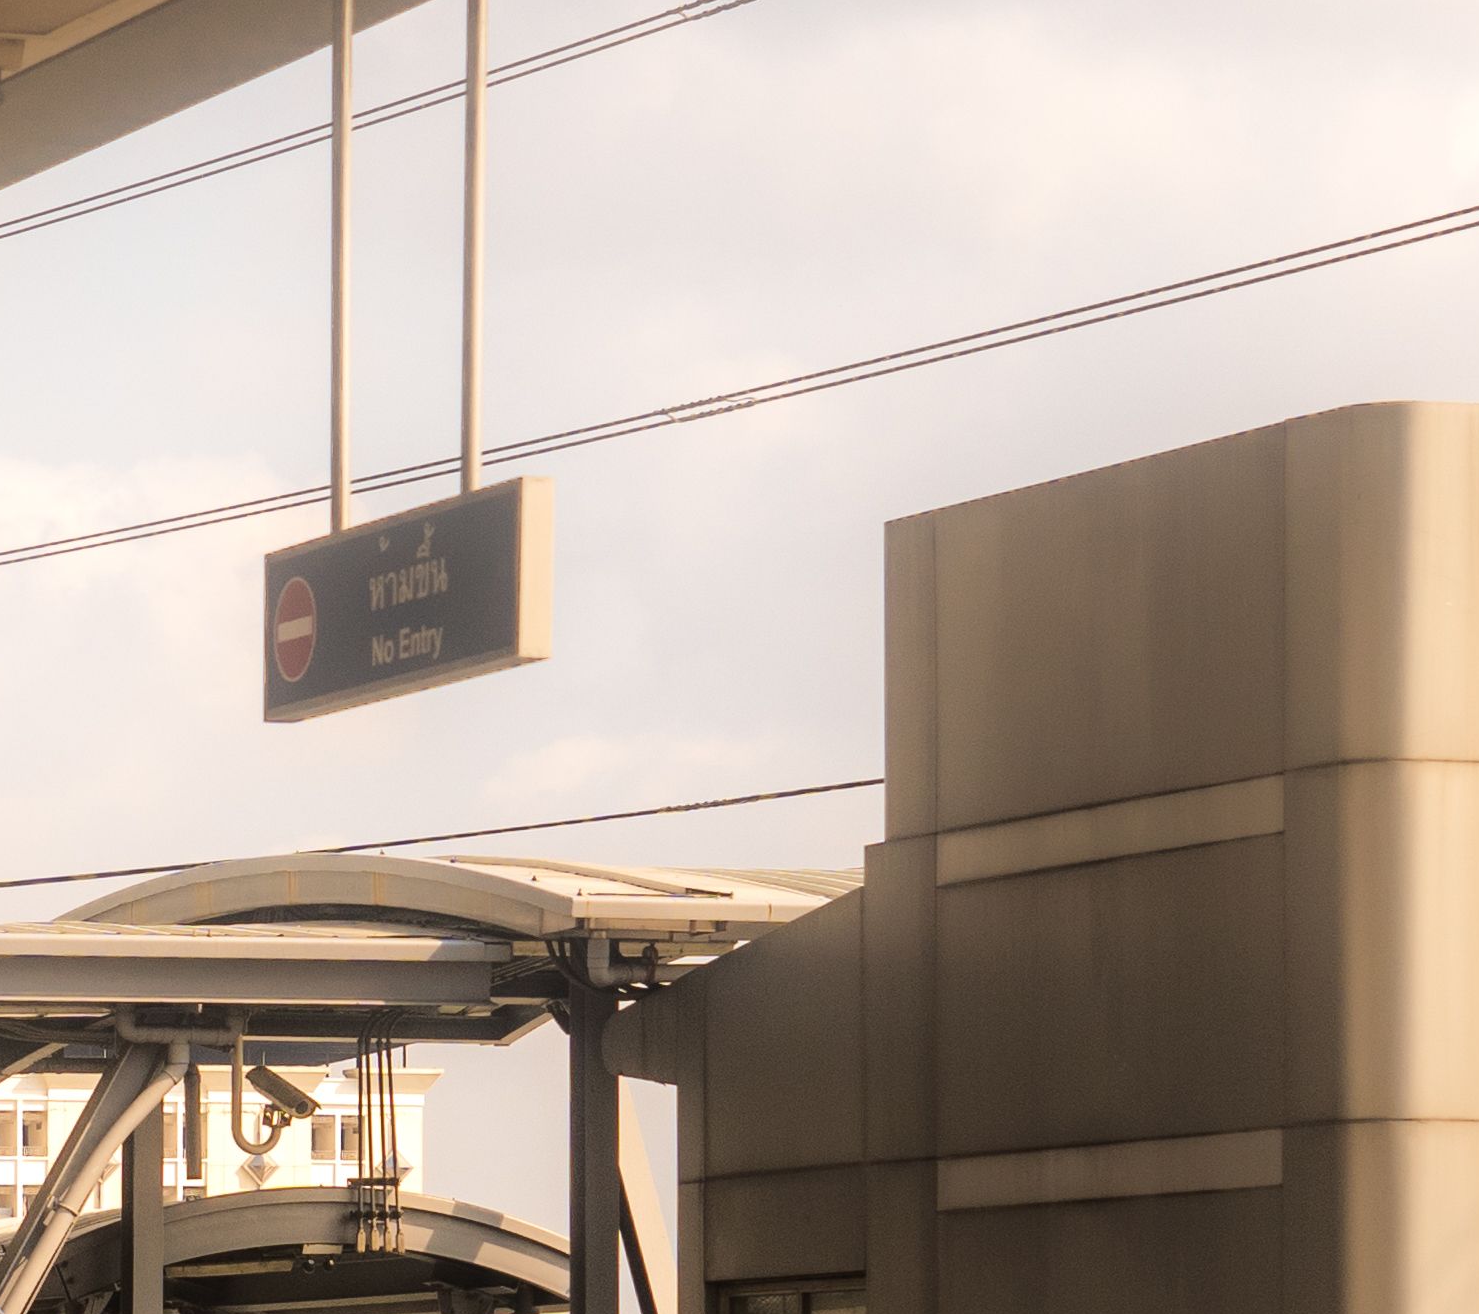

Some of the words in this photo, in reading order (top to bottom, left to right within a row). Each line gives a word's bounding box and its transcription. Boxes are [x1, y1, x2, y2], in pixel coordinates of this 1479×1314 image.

[368, 521, 448, 612] ห้ามขึ้น
[371, 634, 393, 666] No
[398, 623, 444, 661] Entry
